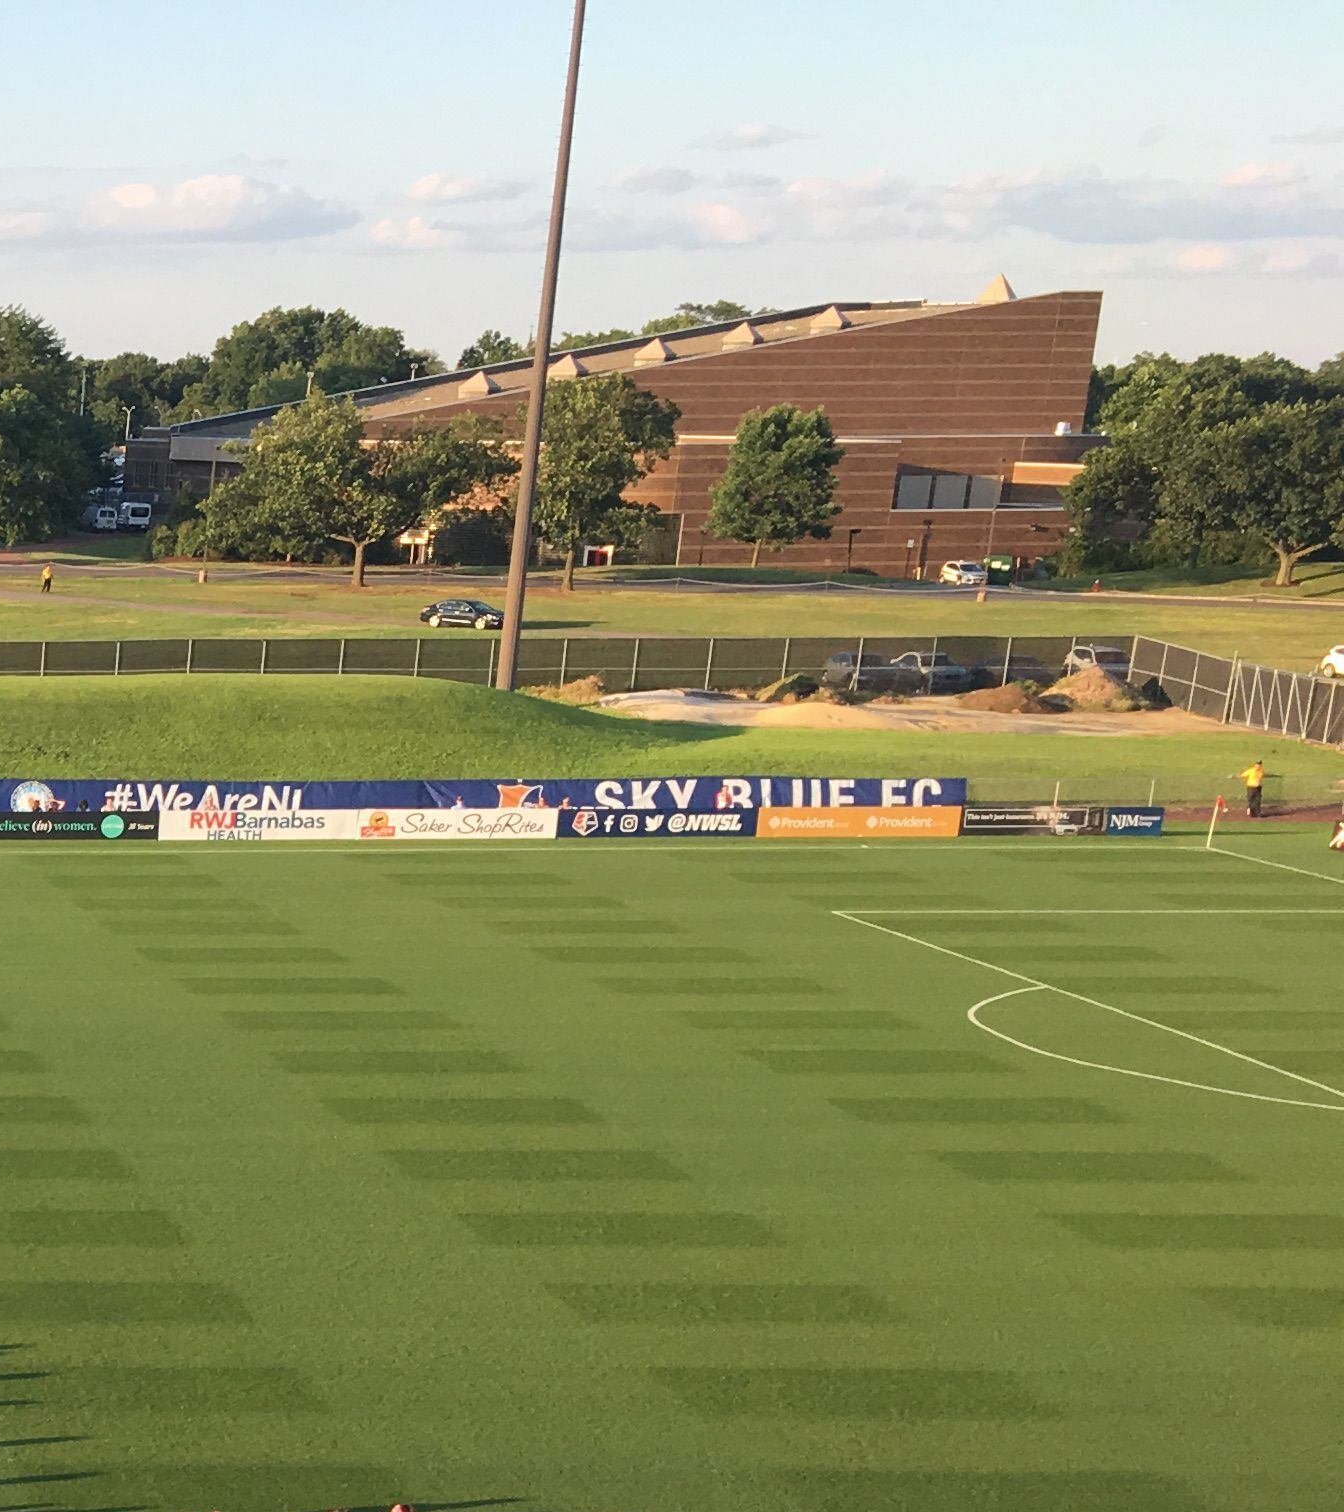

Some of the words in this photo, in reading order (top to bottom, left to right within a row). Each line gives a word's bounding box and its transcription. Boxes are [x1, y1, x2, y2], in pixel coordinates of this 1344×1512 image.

[594, 779, 697, 809] SKY
[881, 778, 941, 808] FC
[31, 820, 53, 833] (in)
[53, 823, 97, 832] women.
[189, 811, 326, 830] RWJBarnabas
[400, 812, 453, 834] Saker
[457, 812, 545, 840] ShopRites
[668, 812, 743, 832] @NWSL
[781, 817, 834, 829] Provident
[879, 816, 934, 828] Provident
[1109, 814, 1140, 830] NJM
[206, 830, 262, 841] HEALTH
